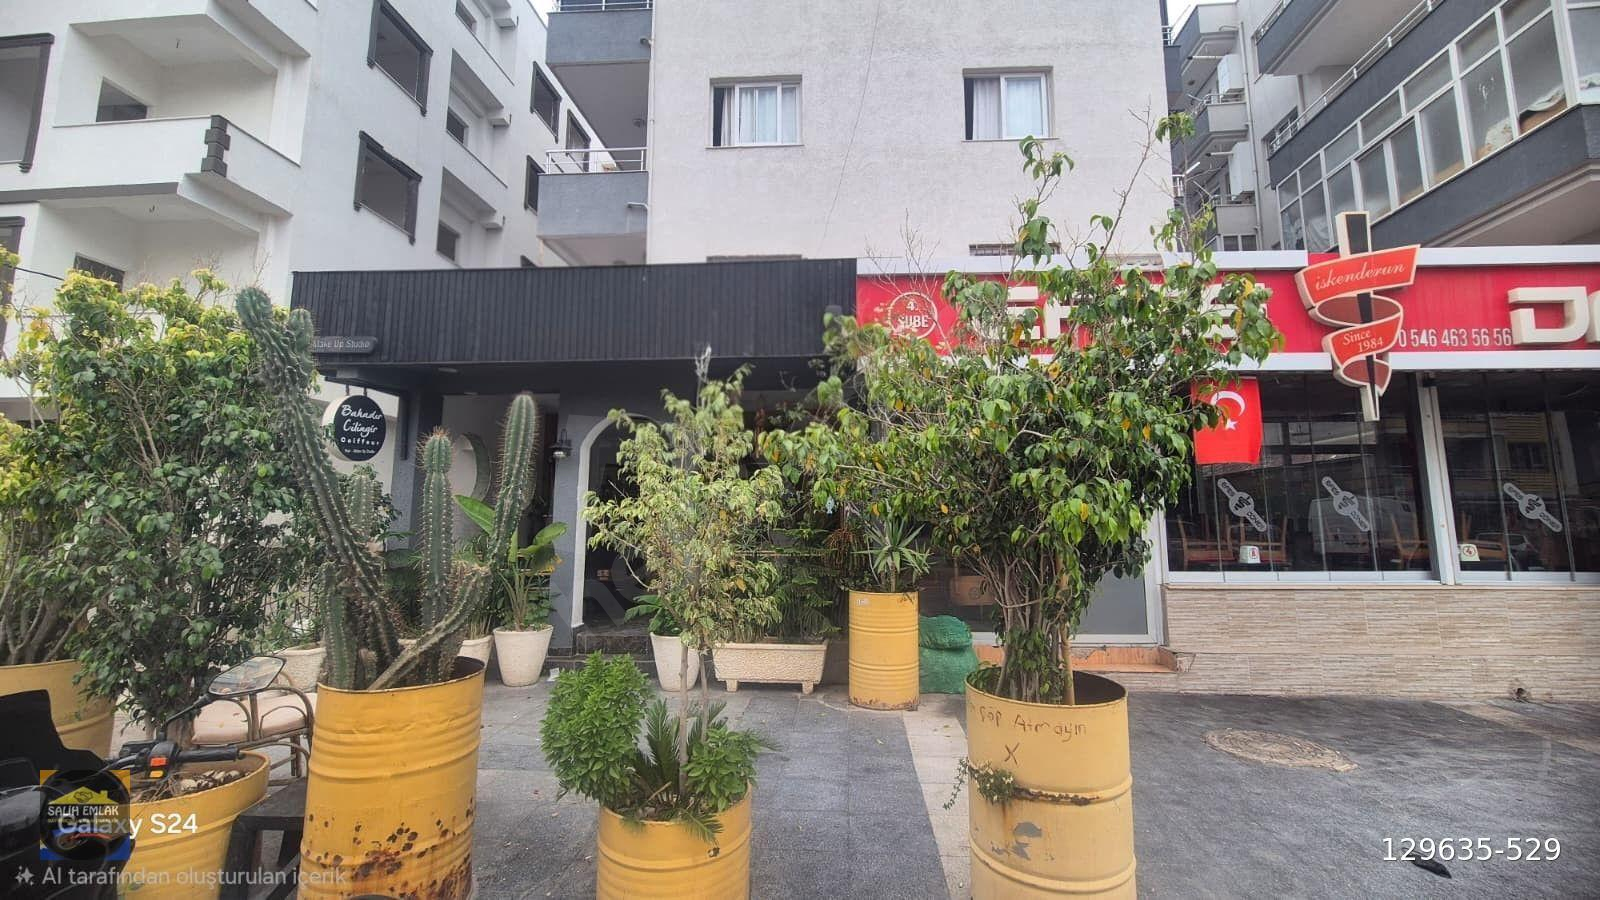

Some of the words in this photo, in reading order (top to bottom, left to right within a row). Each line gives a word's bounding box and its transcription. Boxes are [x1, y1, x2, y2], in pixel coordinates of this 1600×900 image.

[1315, 262, 1406, 291] iskenderun
[1508, 286, 1600, 344] D
[1343, 330, 1371, 345] Since
[1358, 337, 1384, 352] 1984
[1410, 329, 1438, 347] 546
[1441, 329, 1468, 347] 463
[1471, 329, 1490, 347] 56
[1493, 328, 1512, 346] 56
